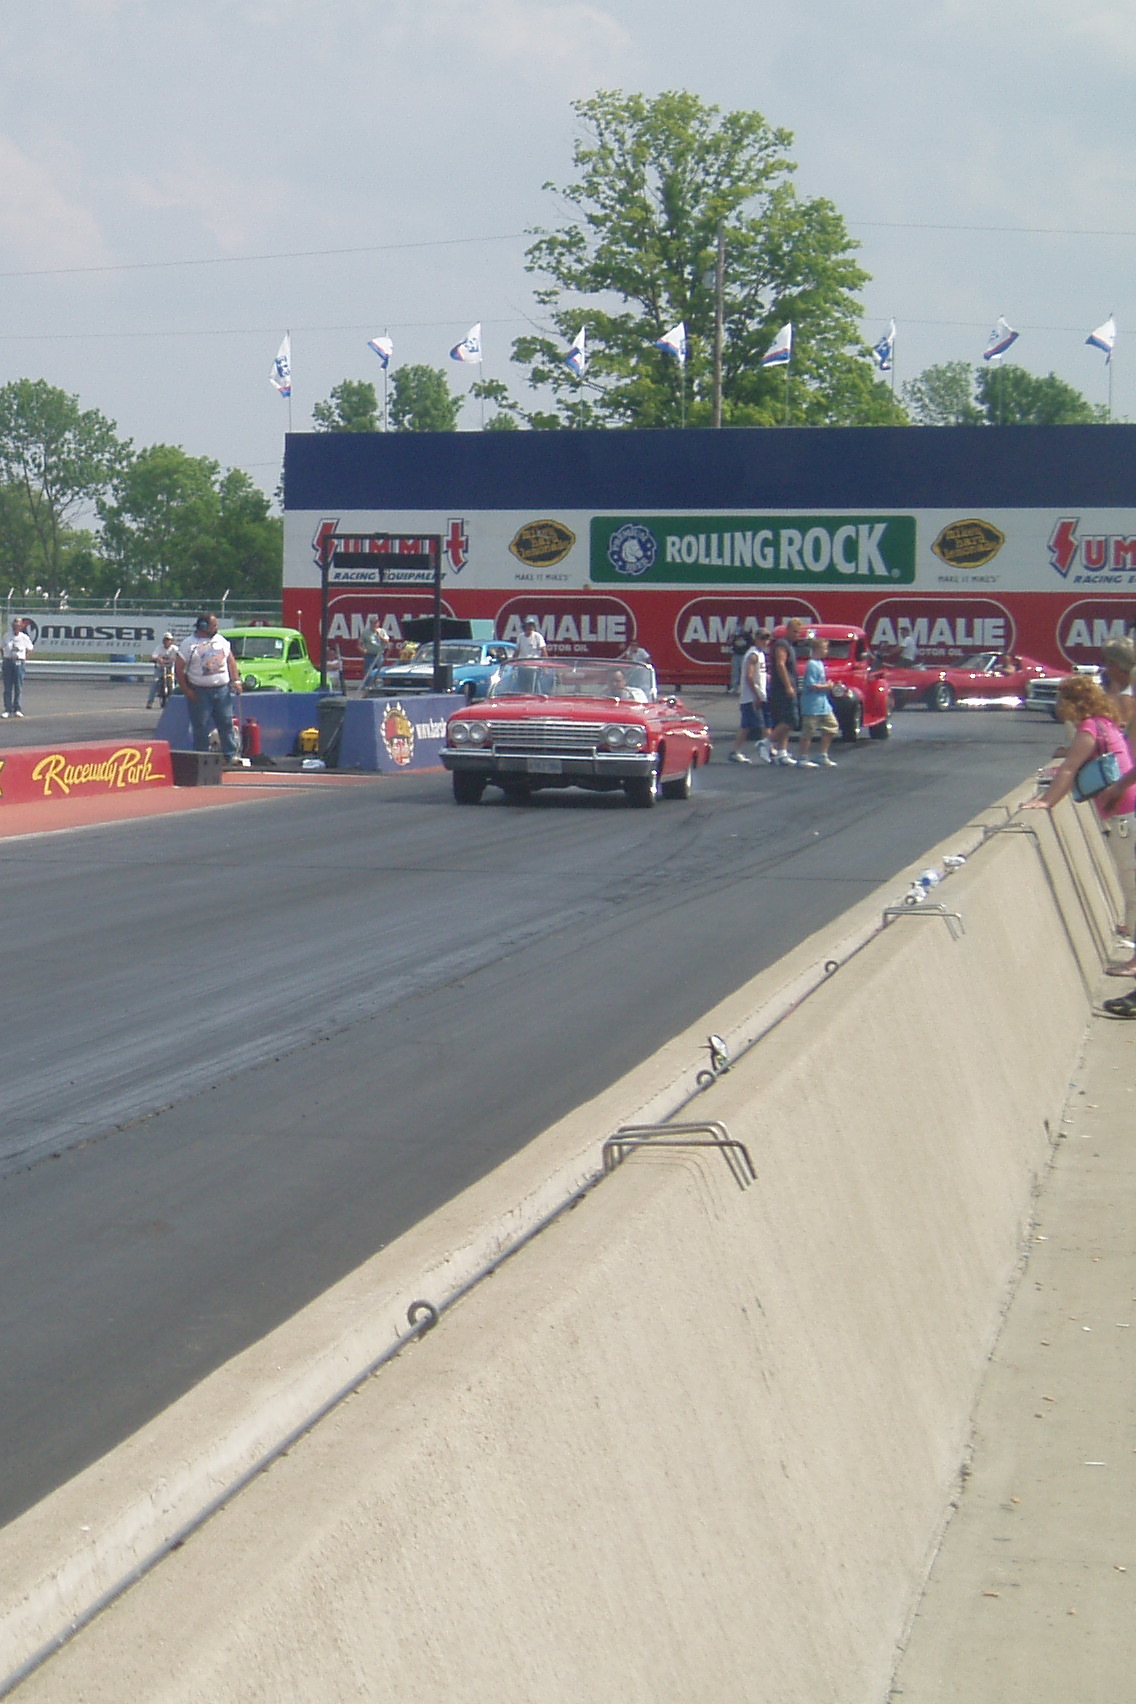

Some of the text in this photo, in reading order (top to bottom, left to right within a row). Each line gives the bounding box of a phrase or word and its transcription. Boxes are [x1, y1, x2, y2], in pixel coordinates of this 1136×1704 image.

[665, 530, 775, 569] ROLLING
[779, 522, 889, 577] ROCK
[334, 572, 446, 580] RACING QUIPMET
[1073, 575, 1122, 583] RACING
[41, 625, 154, 640] MOSER
[327, 613, 448, 640] AMA
[502, 614, 627, 642] AMALIE
[682, 615, 812, 643] AMA
[870, 617, 1005, 645] AMALIE
[1065, 618, 1135, 647] AM
[544, 643, 571, 651] OTOR
[917, 648, 946, 656] OTOR
[32, 754, 117, 795] Raceway
[111, 747, 166, 787] Park
